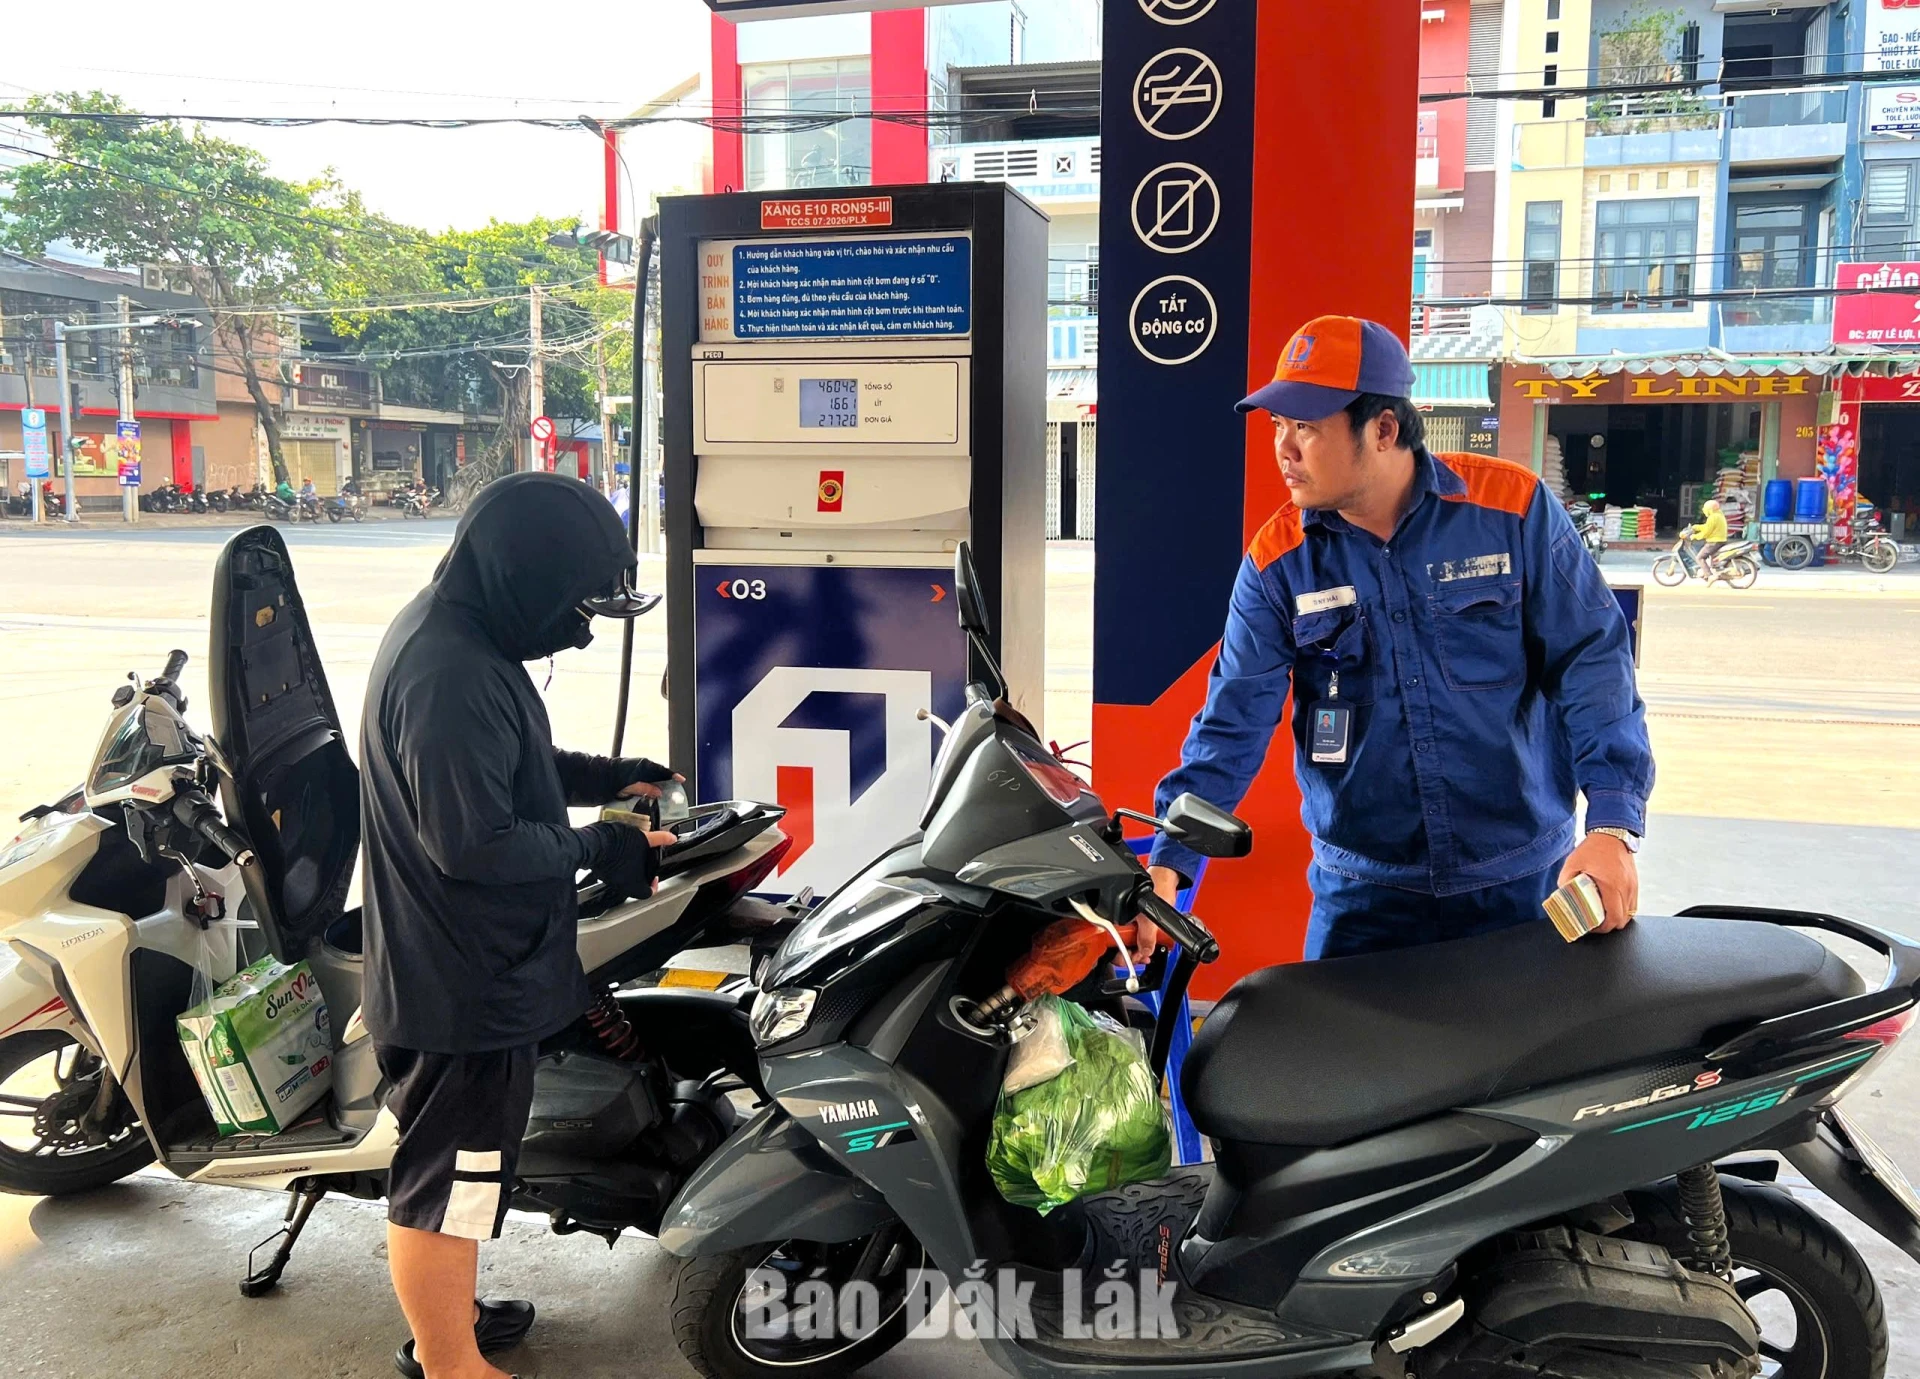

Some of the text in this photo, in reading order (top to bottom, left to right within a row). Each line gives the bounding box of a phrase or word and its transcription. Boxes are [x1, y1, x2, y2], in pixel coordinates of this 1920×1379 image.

[1881, 60, 1901, 70] TOLE
[764, 201, 889, 217] XĂNG E10 RON95-III
[786, 216, 867, 226] TCCS 07:2026/PLX
[784, 248, 803, 258] khách
[805, 248, 821, 259] hàng
[823, 248, 835, 257] vào
[856, 246, 872, 256] chào
[885, 246, 894, 254] và
[895, 245, 906, 254] xác
[908, 244, 926, 256] nhận
[927, 244, 940, 253] nhu
[706, 254, 724, 268] QUY
[747, 264, 800, 275] của khách hàng.
[702, 273, 729, 289] TRÌNH
[740, 280, 746, 289] 2.
[747, 280, 759, 289] Mời
[760, 279, 780, 289] khách
[782, 278, 798, 289] hàng
[800, 278, 811, 288] xác
[812, 278, 829, 289] nhận
[831, 277, 846, 287] màn
[847, 276, 862, 286] hình
[864, 276, 874, 287] cột
[876, 276, 891, 285] bơm
[892, 276, 909, 286] đang
[707, 294, 726, 310] BÁN
[740, 296, 746, 304] 3.
[747, 295, 763, 304] Bơm
[764, 294, 780, 305] hàng
[811, 294, 827, 302] theo
[828, 292, 840, 303] yêu
[855, 291, 867, 301] của
[868, 291, 889, 300] khách
[890, 290, 910, 302] hàng.
[1159, 293, 1187, 314] TẮT
[740, 304, 964, 319] 4. Mời khách hàng xác nhận màn hình cột bơm trước khi thanh toán.
[704, 315, 729, 331] HÀNG
[740, 324, 746, 333] 5.
[748, 324, 764, 333] Thực
[765, 323, 780, 334] hiện
[781, 323, 800, 332] thanh
[802, 322, 816, 332] toán
[817, 322, 826, 331] và
[827, 322, 838, 331] xác
[840, 321, 856, 332] nhận
[913, 320, 934, 329] khách
[935, 320, 954, 331] hàng.
[1142, 318, 1205, 339] ĐỘNG CƠ
[705, 351, 723, 359] PECO
[819, 380, 856, 393] 46042
[1632, 376, 1810, 397] LINH
[819, 414, 857, 427] 27720
[1470, 433, 1492, 443] 203
[1796, 426, 1814, 438] 205
[731, 579, 767, 601] 03
[1572, 1084, 1691, 1122] FreeGo
[818, 1099, 880, 1124] YAMAHA
